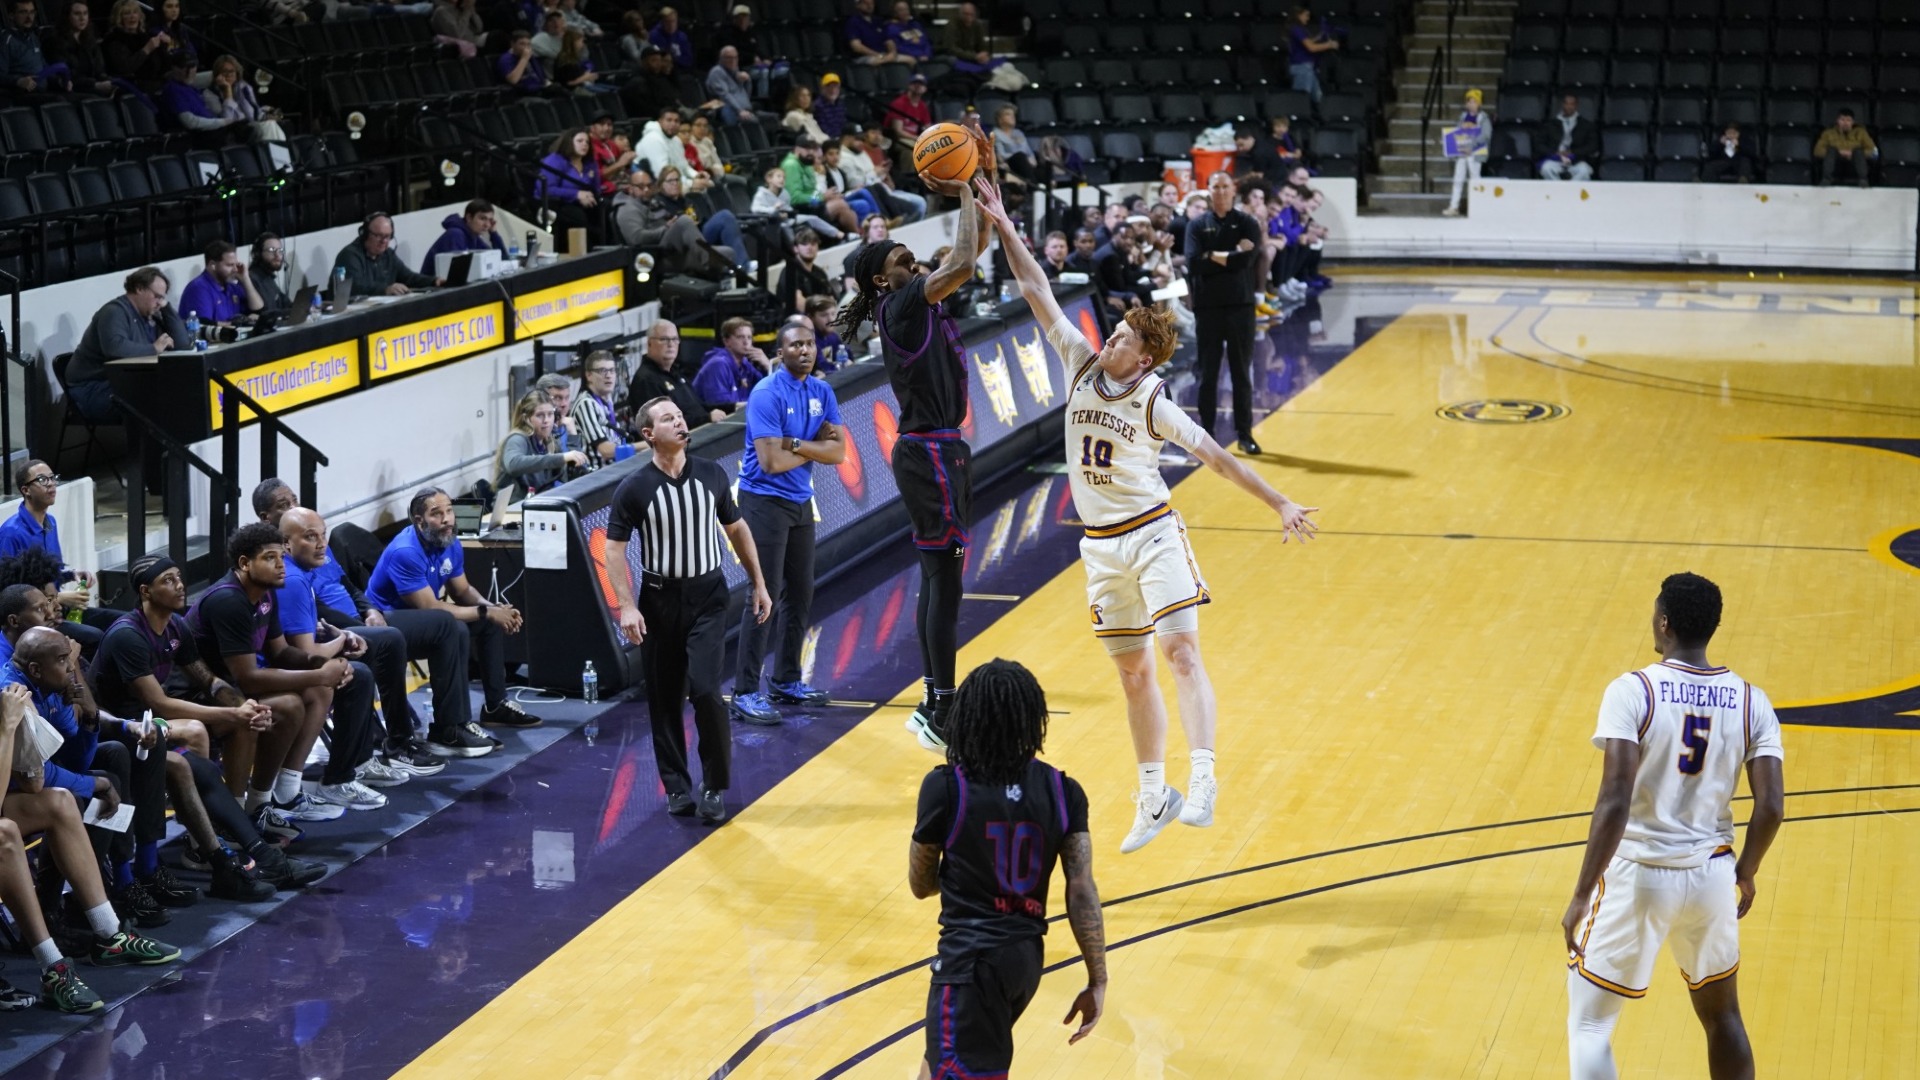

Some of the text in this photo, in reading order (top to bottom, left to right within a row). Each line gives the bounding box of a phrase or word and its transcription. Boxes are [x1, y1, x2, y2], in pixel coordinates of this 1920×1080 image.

[916, 135, 954, 162] Wilson
[1433, 286, 1920, 314] TENN
[1071, 409, 1137, 443] TENNESSEE
[1081, 435, 1113, 467] 10
[1660, 681, 1737, 709] FLORENCE
[1677, 713, 1712, 776] 5
[985, 821, 1043, 895] 10
